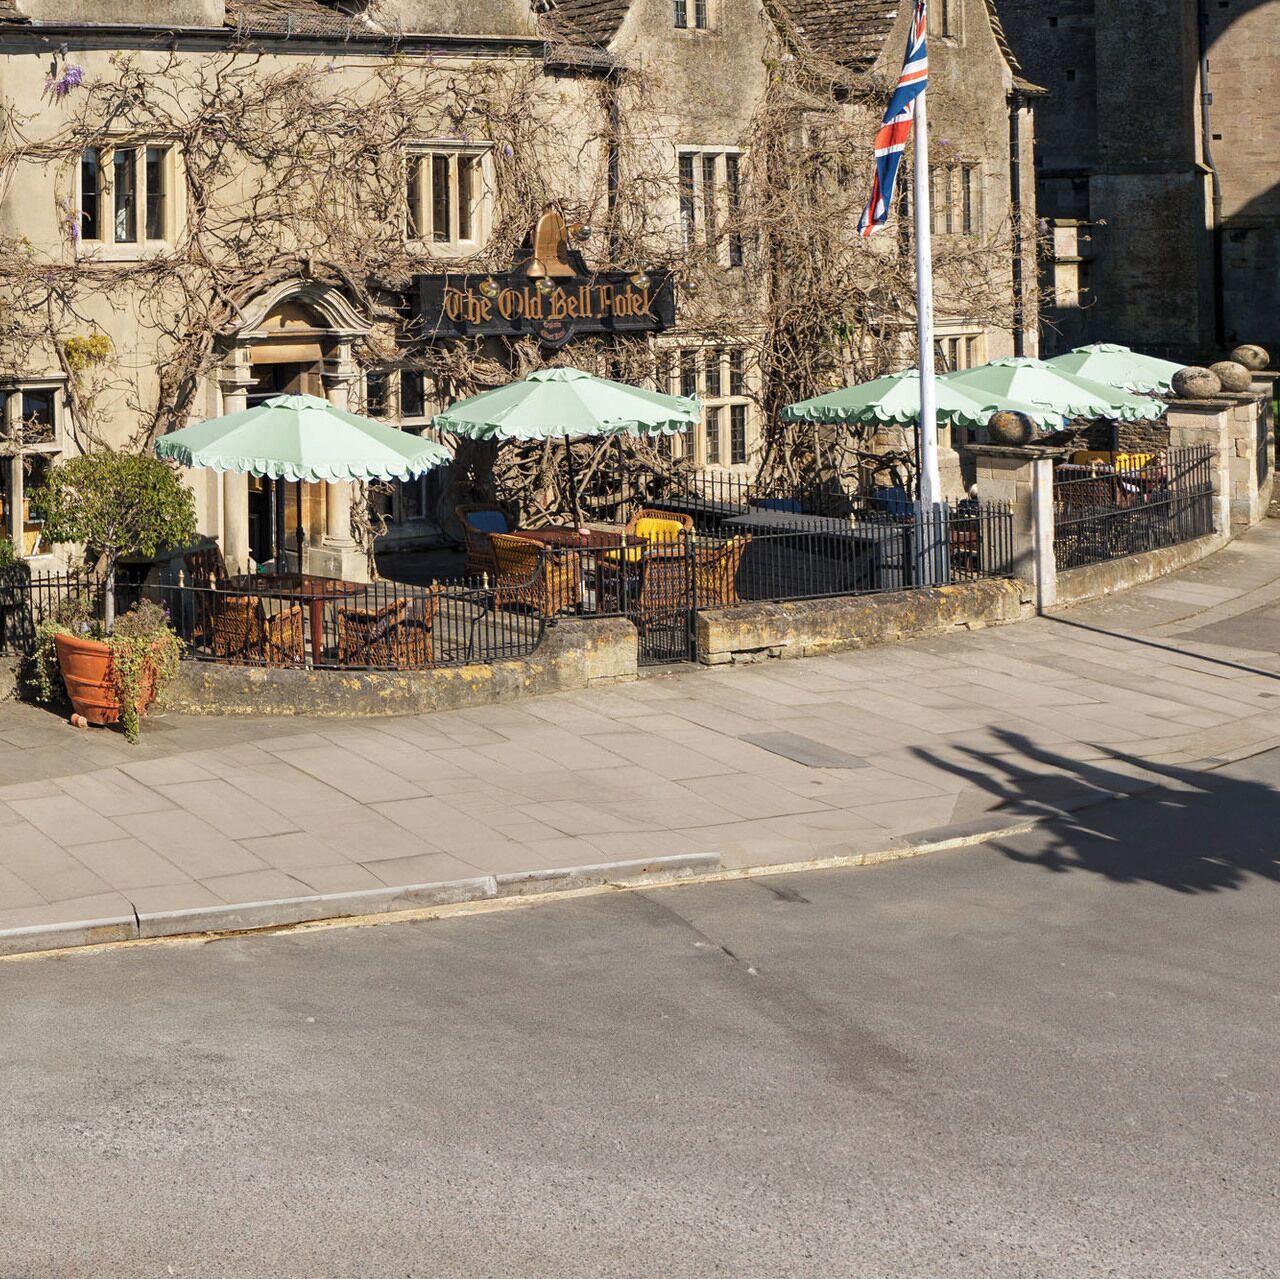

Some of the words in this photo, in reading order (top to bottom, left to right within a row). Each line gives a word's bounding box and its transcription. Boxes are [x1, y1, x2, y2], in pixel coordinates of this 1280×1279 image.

[442, 286, 493, 324] The
[497, 286, 543, 321] Old
[548, 285, 593, 320] Bell
[595, 284, 651, 320] Hotel
